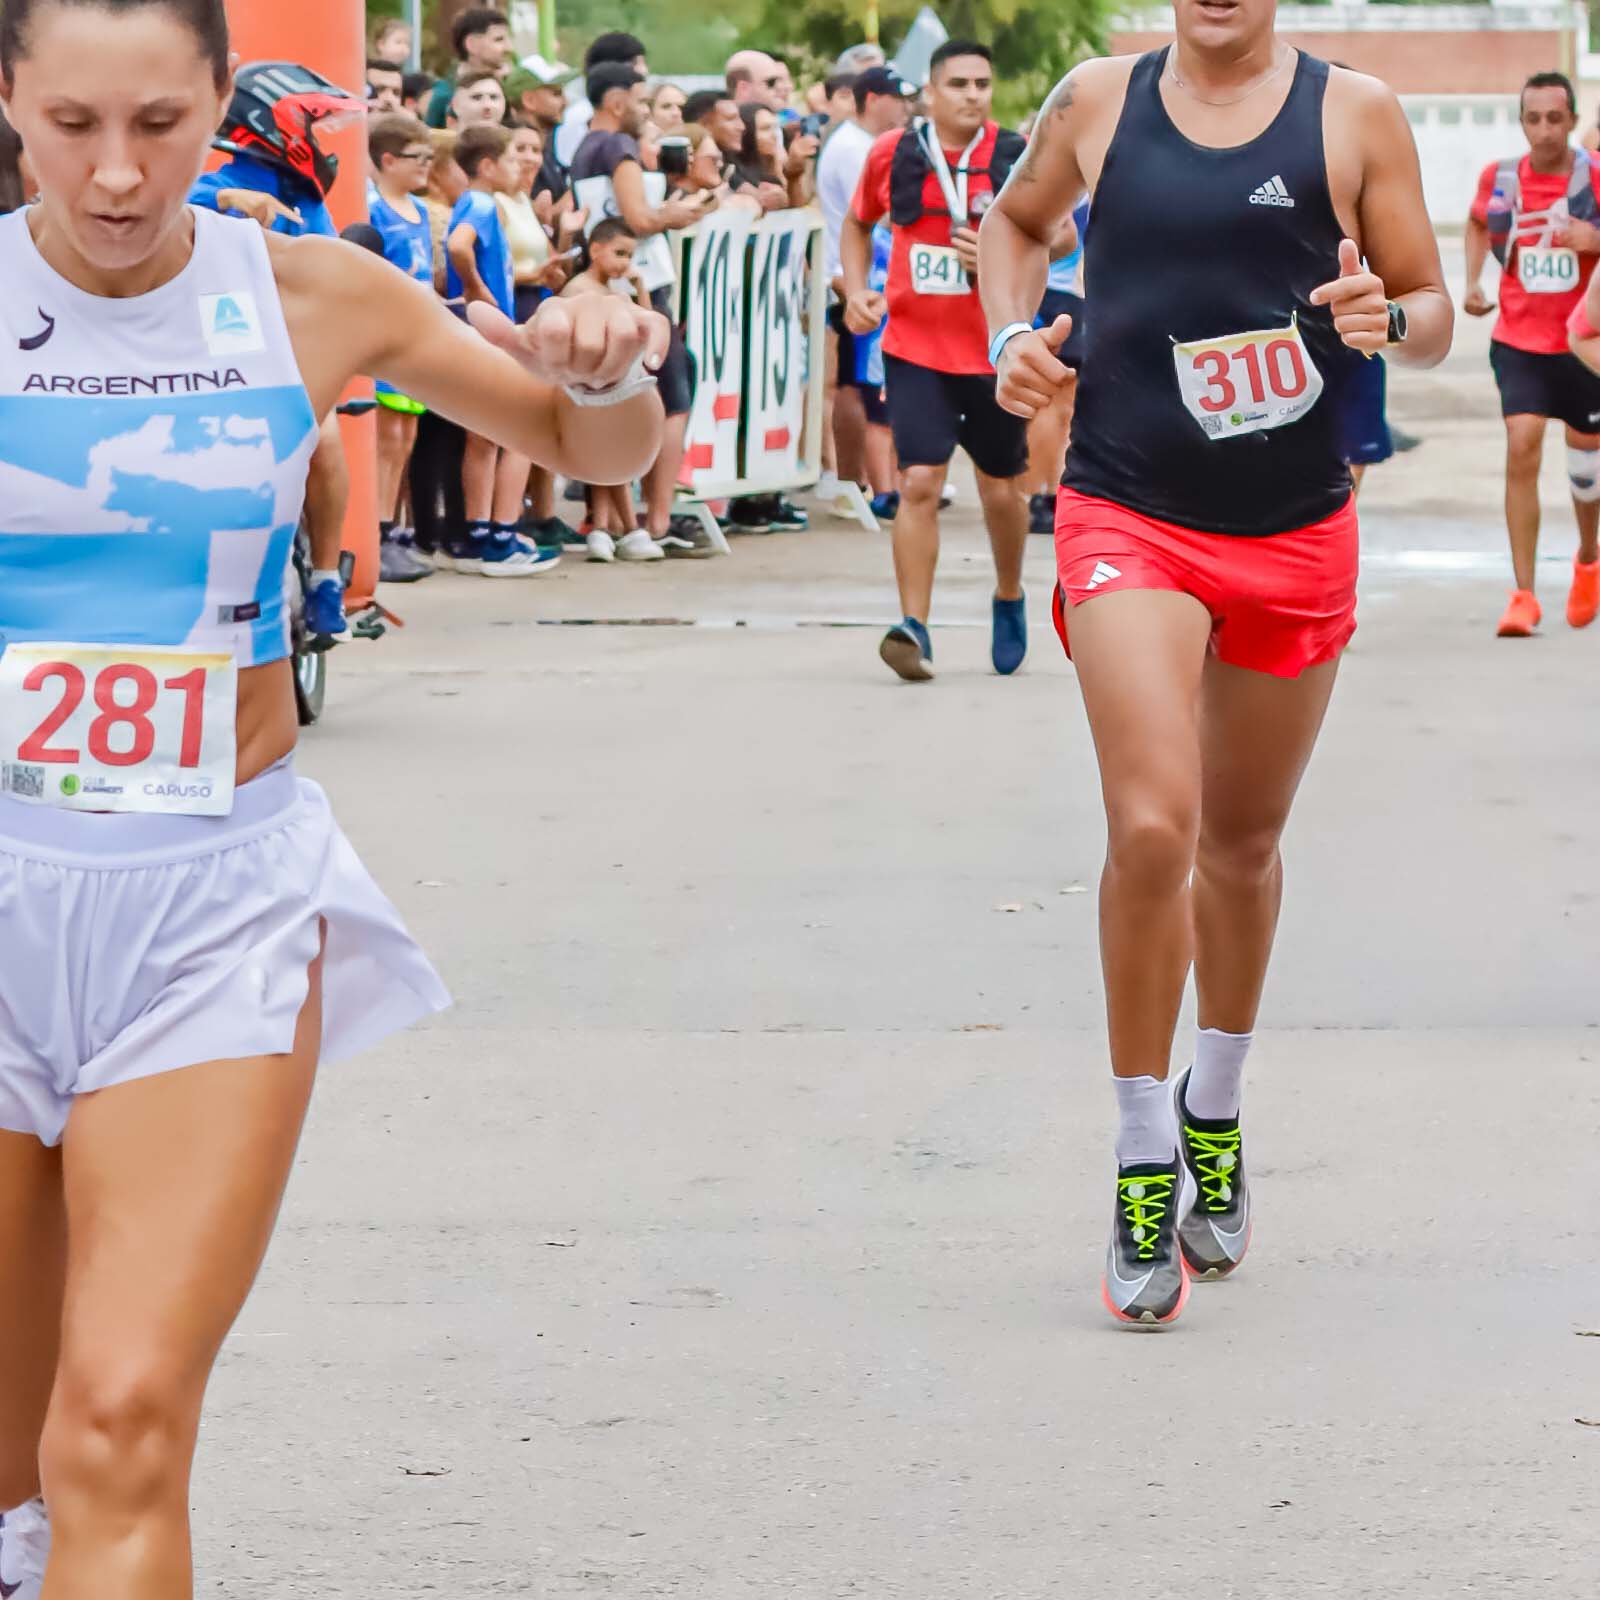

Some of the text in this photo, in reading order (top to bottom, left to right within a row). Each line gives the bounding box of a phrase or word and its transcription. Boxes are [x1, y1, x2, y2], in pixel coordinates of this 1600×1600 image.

[1248, 194, 1295, 208] adidas
[1522, 252, 1573, 280] 840
[22, 367, 248, 395] ARGENTINA
[1193, 339, 1308, 413] 310
[17, 661, 207, 769] 281
[143, 783, 213, 799] CARUSO
